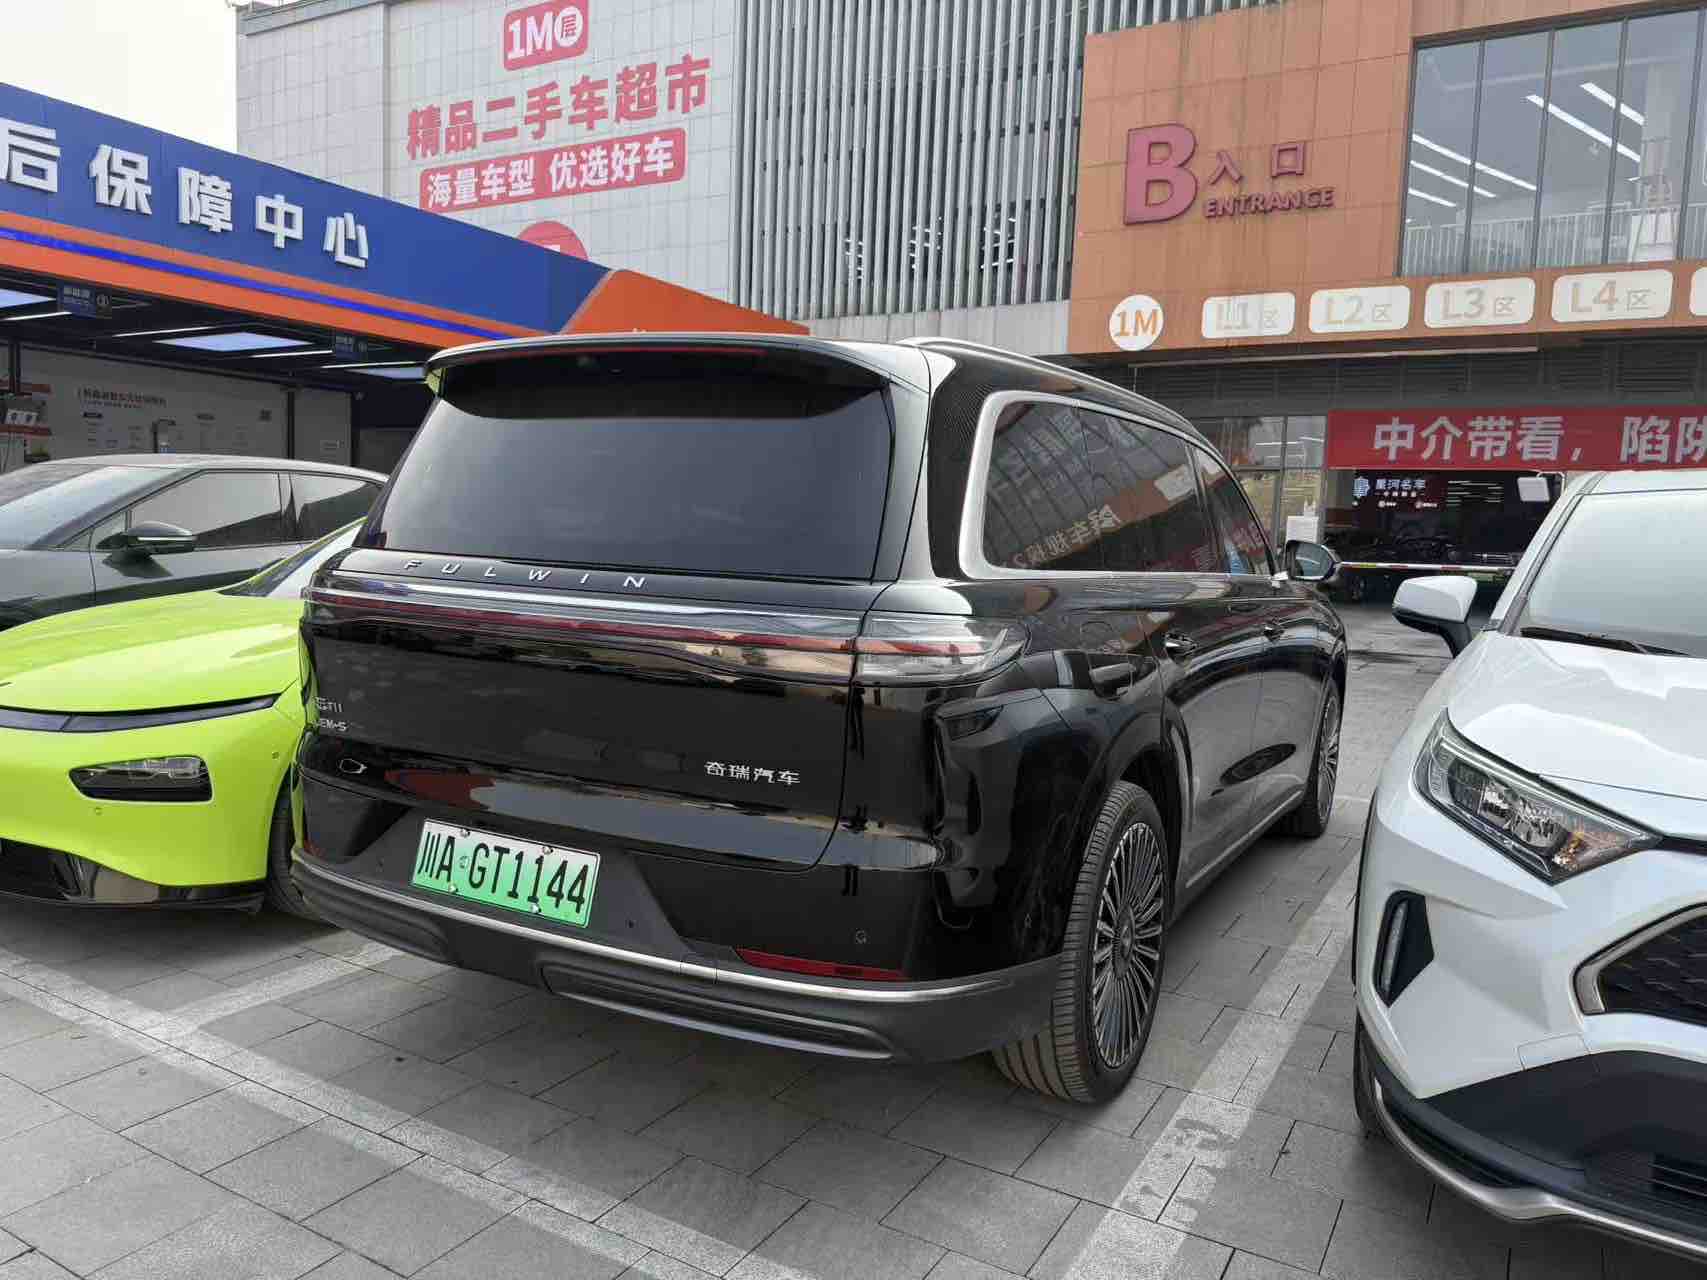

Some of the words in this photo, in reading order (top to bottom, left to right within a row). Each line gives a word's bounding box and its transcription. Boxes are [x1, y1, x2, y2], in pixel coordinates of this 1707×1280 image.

[406, 54, 712, 161] 精品二手车超市
[427, 157, 536, 209] 海量车型
[549, 137, 675, 192] 优选好车
[1124, 123, 1199, 225] B
[1206, 141, 1307, 185] 入口
[0, 117, 370, 268] 后保障中心
[1204, 187, 1336, 219] ENTRANCE
[1441, 287, 1517, 320] L3区
[1570, 279, 1657, 312] L4区
[1113, 308, 1160, 338] 1M
[403, 558, 646, 589] FULWIN
[704, 761, 801, 785] 奇瑞汽车
